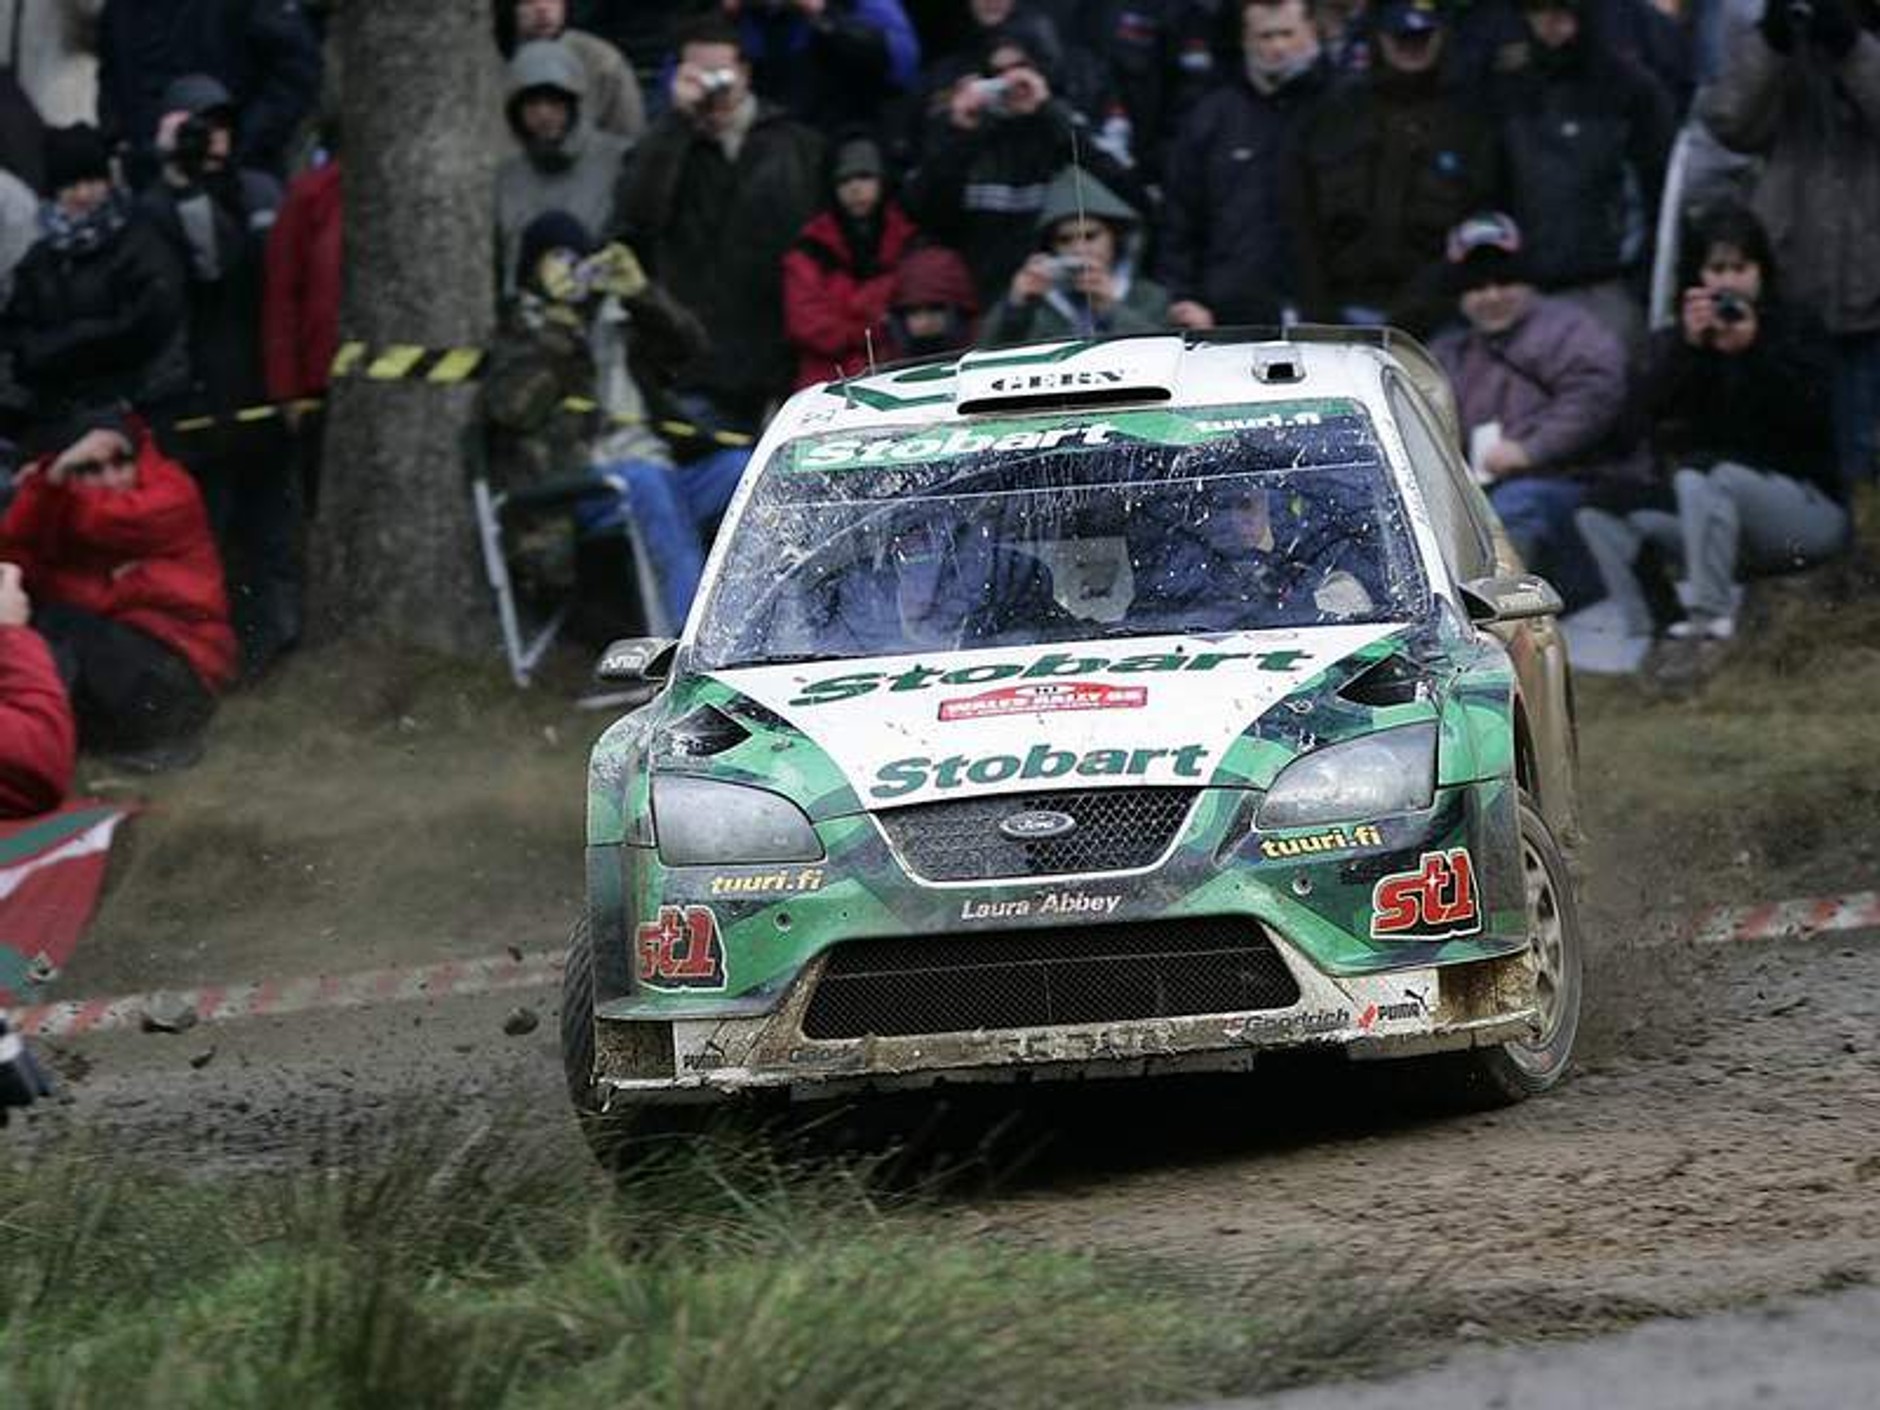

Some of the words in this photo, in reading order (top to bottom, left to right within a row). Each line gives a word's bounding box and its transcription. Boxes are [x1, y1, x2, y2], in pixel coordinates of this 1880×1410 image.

[805, 419, 1113, 464] Stobart
[789, 649, 1313, 706] Stobart
[869, 745, 1209, 798] Stobart
[1261, 826, 1381, 856] tuuri.fi
[710, 870, 824, 894] tuuri.fi
[961, 899, 1030, 919] Laura
[1040, 892, 1121, 916] Abbey
[1377, 1002, 1420, 1020] PUMA
